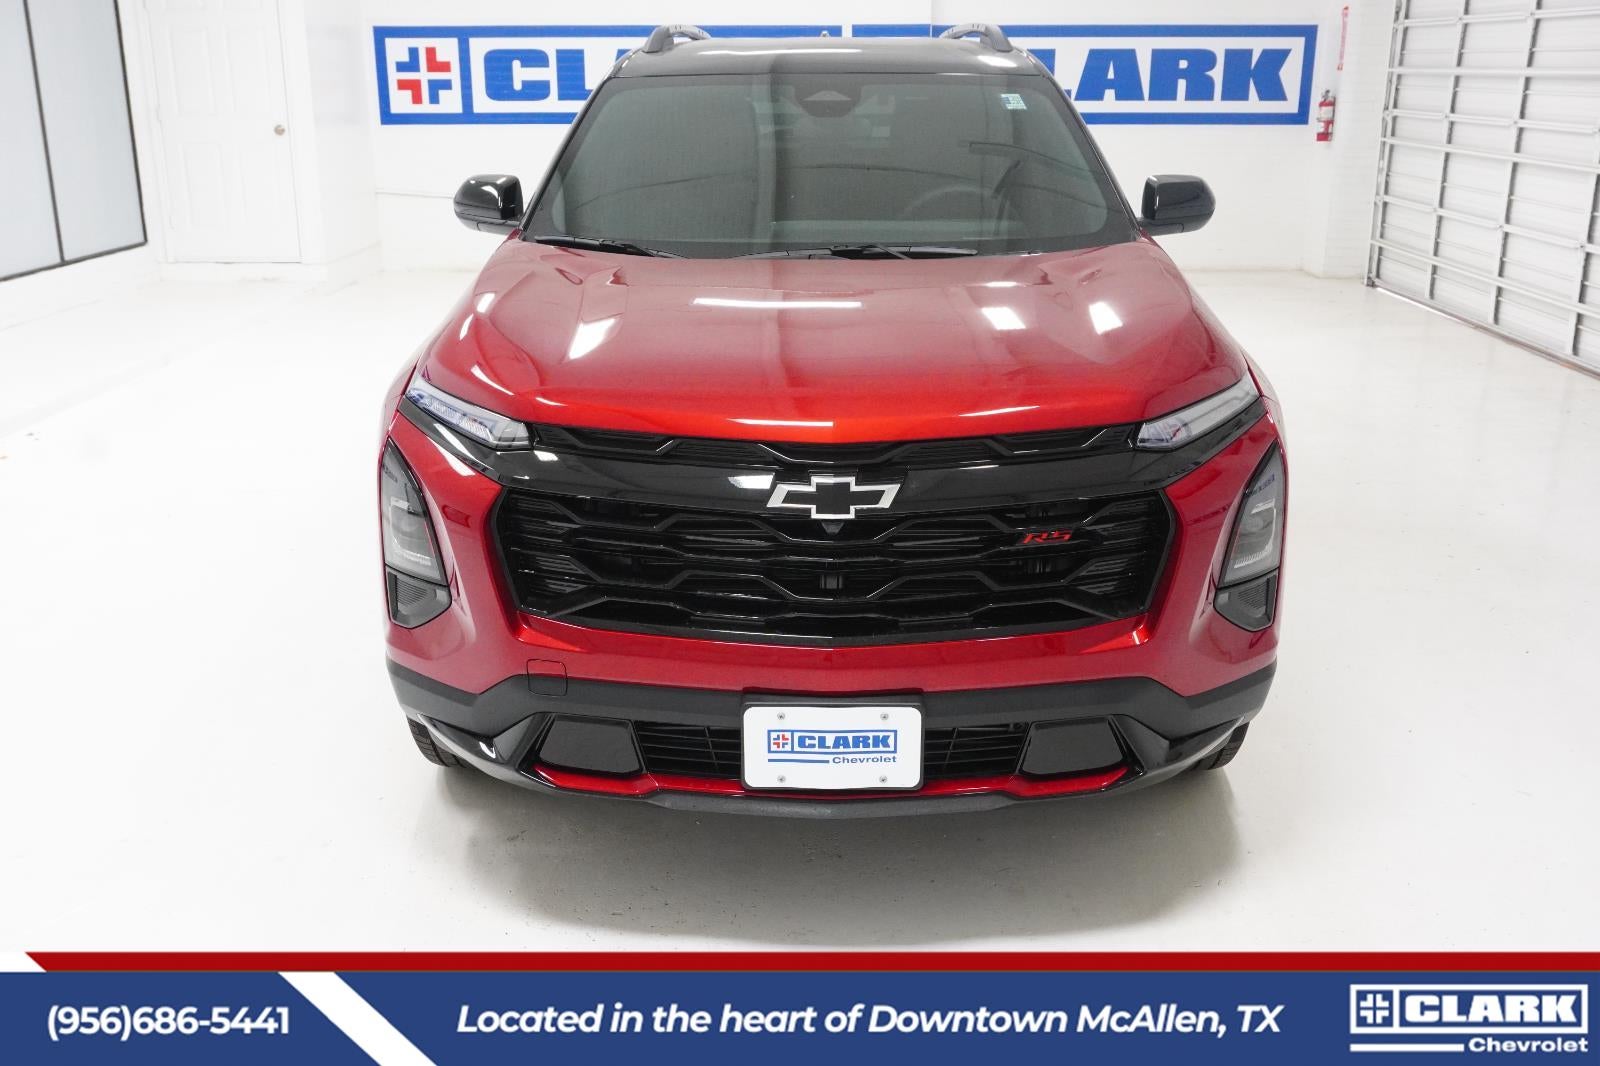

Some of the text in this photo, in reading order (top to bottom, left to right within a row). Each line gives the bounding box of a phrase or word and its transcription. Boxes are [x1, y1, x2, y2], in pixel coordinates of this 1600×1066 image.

[1027, 49, 1292, 101] ARK
[1022, 530, 1073, 544] RS
[797, 735, 891, 749] CLARK
[832, 755, 897, 765] Chevrolet
